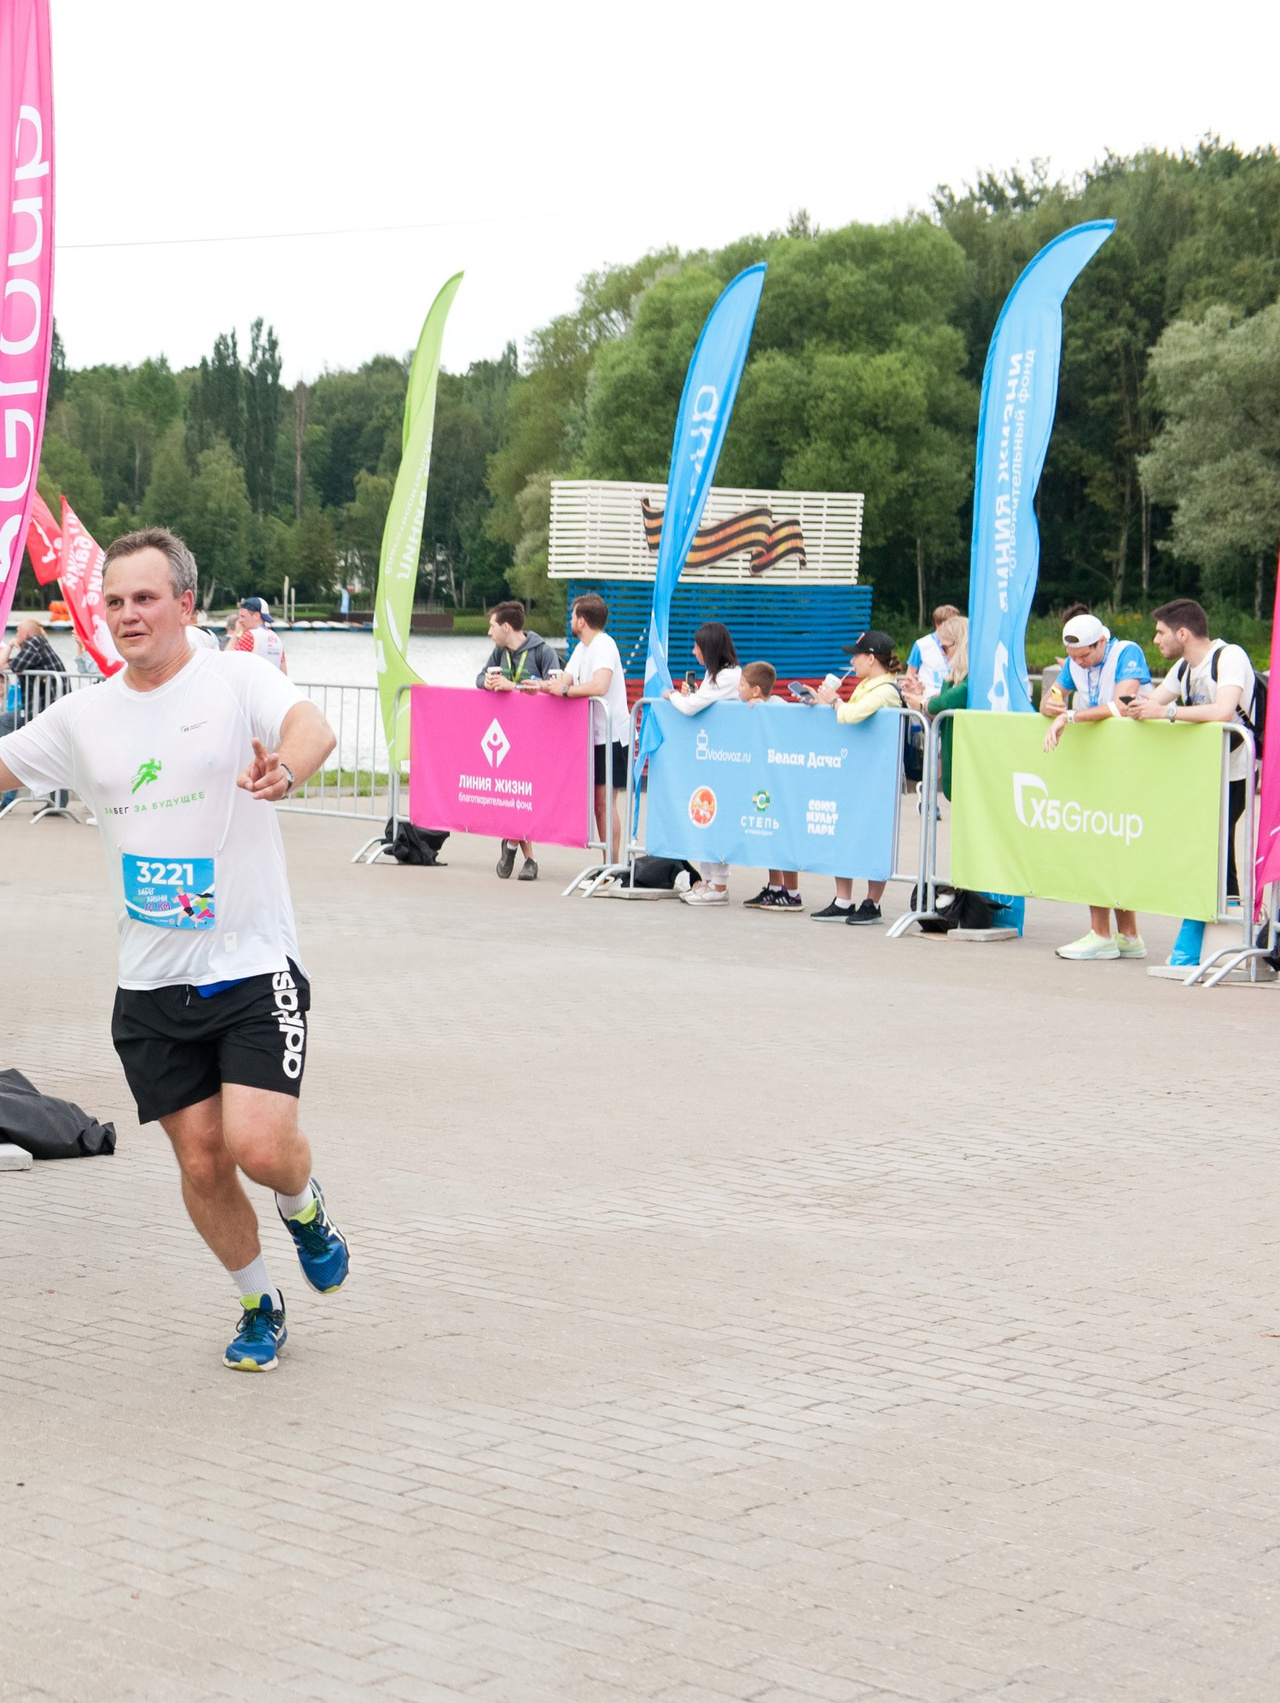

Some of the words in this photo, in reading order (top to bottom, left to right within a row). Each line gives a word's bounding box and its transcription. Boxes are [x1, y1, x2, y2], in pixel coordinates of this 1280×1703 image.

[1016, 348, 1036, 404] фонд
[767, 749, 805, 766] Белая
[807, 752, 841, 768] Дача
[459, 774, 492, 791] ЛИНИЯ
[494, 778, 533, 796] ЖИЗНИ
[104, 806, 130, 815] ЗАБЕГ
[133, 805, 148, 813] ЗА
[151, 791, 206, 810] БУДУЩЕЕ
[458, 792, 515, 808] благотворительный
[515, 799, 533, 812] фонд
[808, 799, 837, 812] СОЮЗ
[740, 815, 780, 830] СТЕПЬ
[806, 811, 839, 825] МУЛЬТ
[807, 824, 835, 836] ПАРК
[136, 860, 194, 886] 3221
